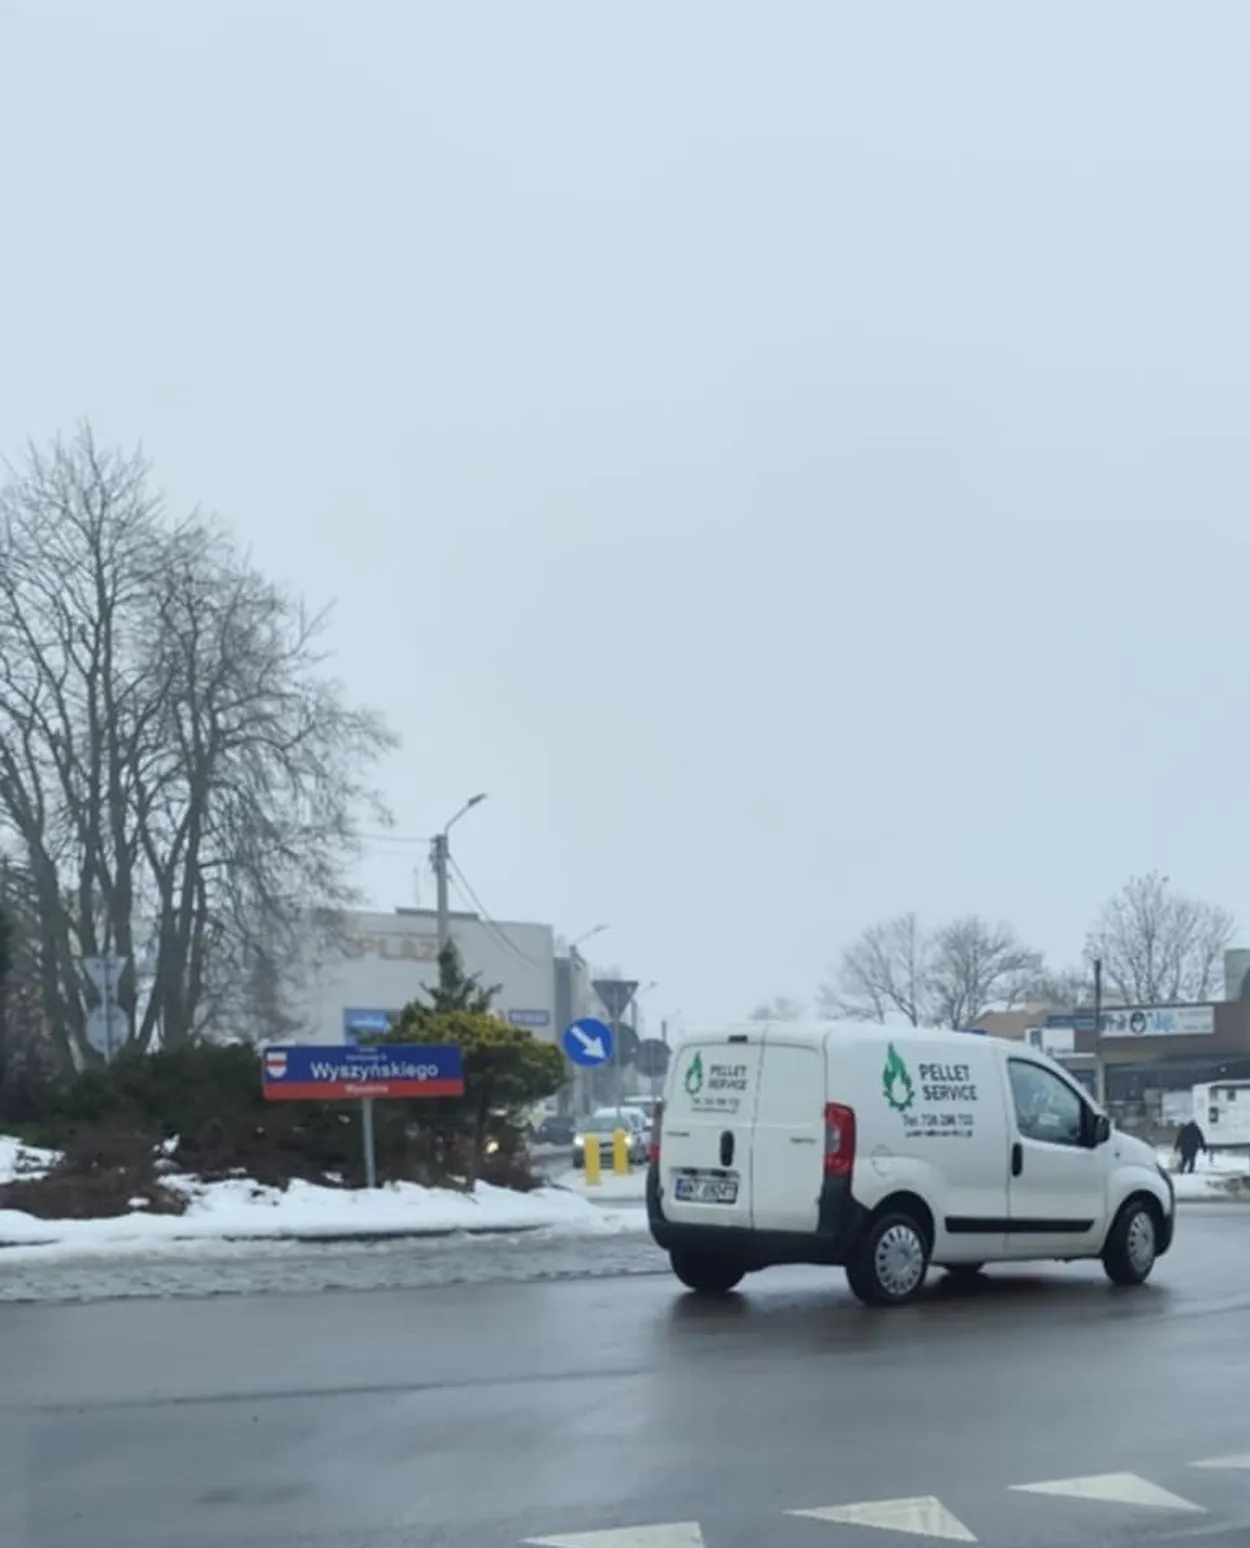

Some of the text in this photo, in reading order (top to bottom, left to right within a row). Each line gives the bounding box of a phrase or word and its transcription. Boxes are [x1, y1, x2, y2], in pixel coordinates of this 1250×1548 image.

[309, 1060, 439, 1081] Wyszyńskiego
[709, 1064, 747, 1078] PELLET
[918, 1062, 969, 1081] PELLET
[708, 1079, 748, 1091] SERVICE
[922, 1084, 978, 1101] SERVICE
